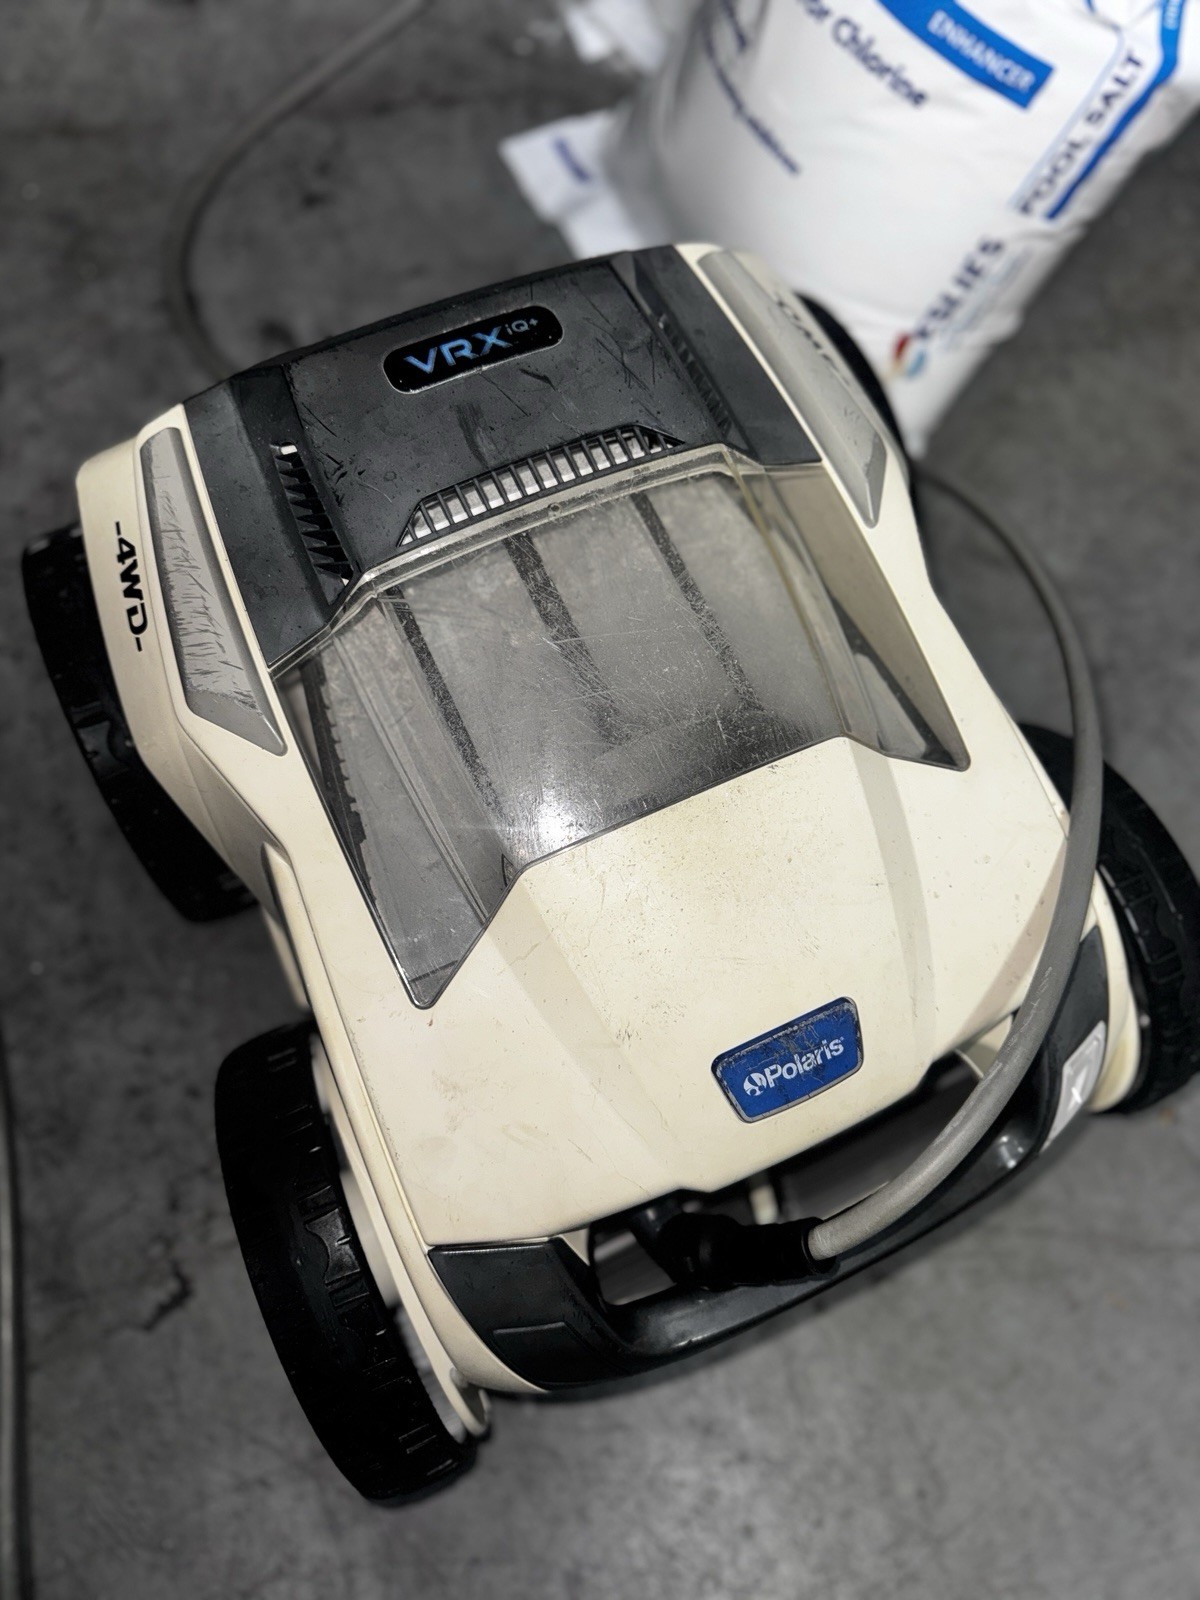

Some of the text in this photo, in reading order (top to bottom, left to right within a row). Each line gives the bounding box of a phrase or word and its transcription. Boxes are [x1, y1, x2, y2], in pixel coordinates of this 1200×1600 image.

[831, 17, 927, 107] Chlorine
[926, 8, 1036, 94] ENHANCER
[1016, 49, 1143, 216] POOL SALT
[403, 325, 513, 375] VRX
[763, 1037, 846, 1089] Polaris
